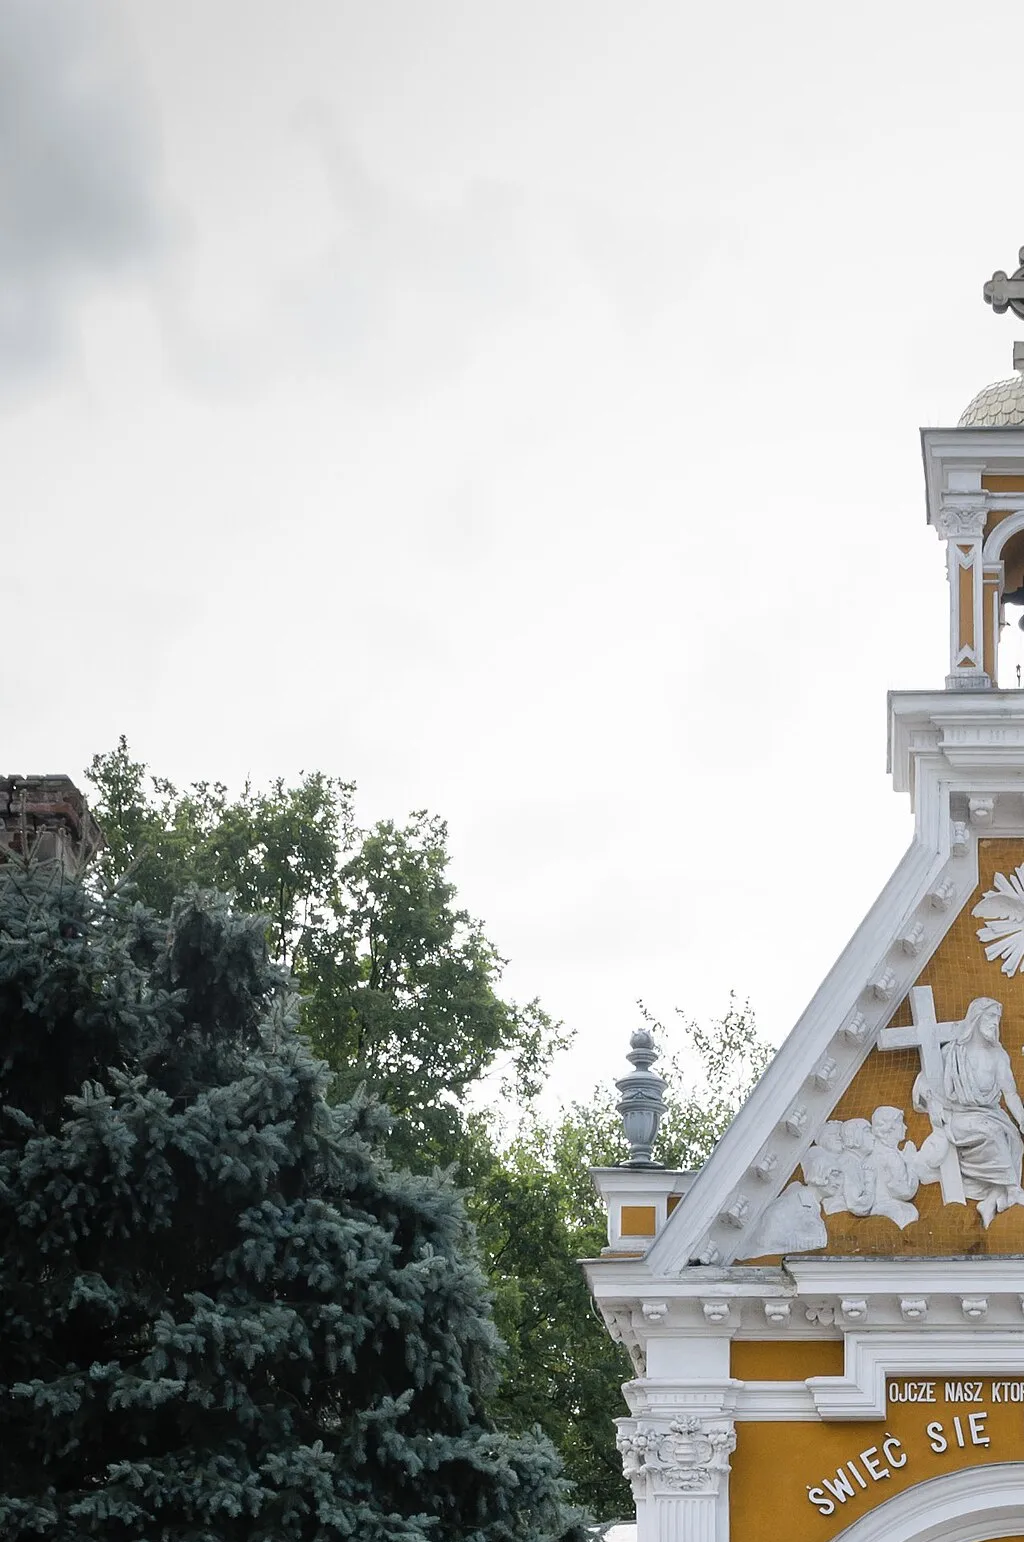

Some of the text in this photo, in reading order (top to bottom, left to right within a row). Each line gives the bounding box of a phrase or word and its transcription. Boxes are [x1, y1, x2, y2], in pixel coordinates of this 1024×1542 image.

[889, 1382, 937, 1403] OJCZE
[944, 1382, 983, 1402] NASZ
[806, 1432, 907, 1515] ŚWIĘĆ
[926, 1411, 990, 1453] SIĘ
